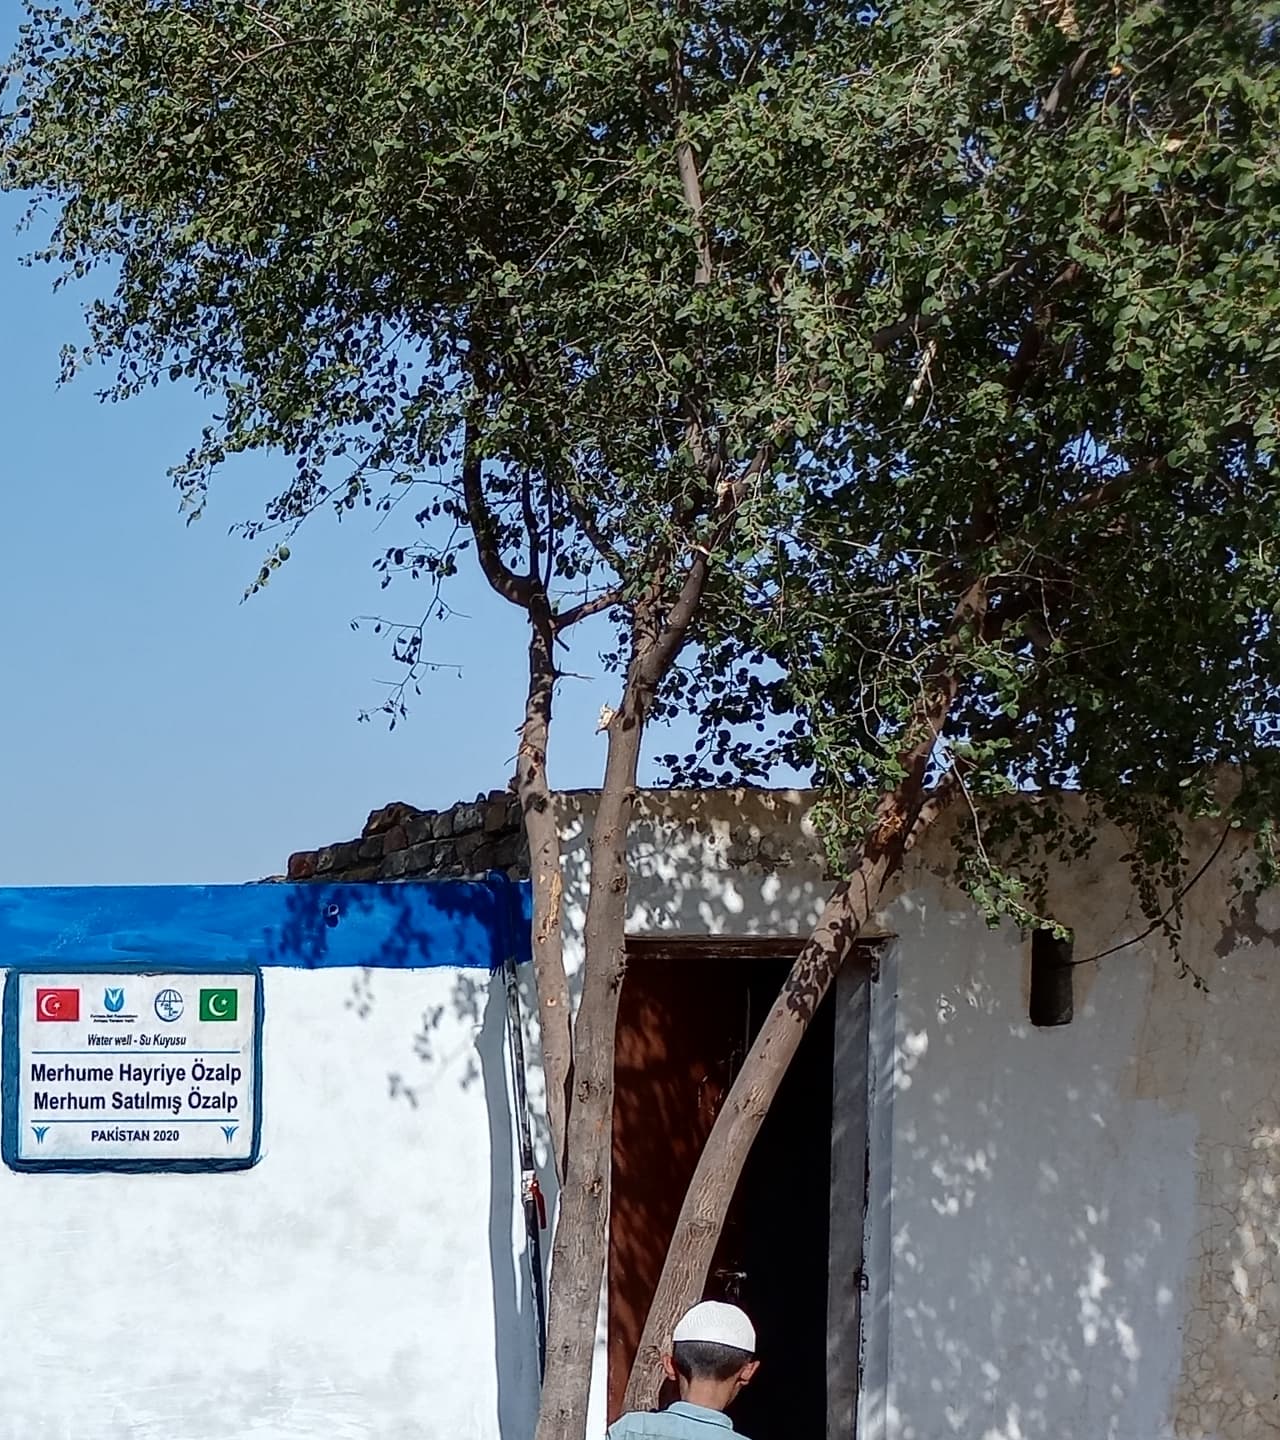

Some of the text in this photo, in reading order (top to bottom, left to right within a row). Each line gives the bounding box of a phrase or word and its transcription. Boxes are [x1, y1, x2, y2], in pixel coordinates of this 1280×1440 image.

[88, 1034, 112, 1046] Water
[115, 1034, 131, 1045] well
[139, 1034, 151, 1045] Su
[153, 1034, 186, 1048] Kuyusu
[31, 1059, 241, 1086] Merhume Hayriye Özalp
[34, 1087, 237, 1114] Merhum Satılmış Özalp
[91, 1127, 179, 1141] PAKİSTAN 2020
